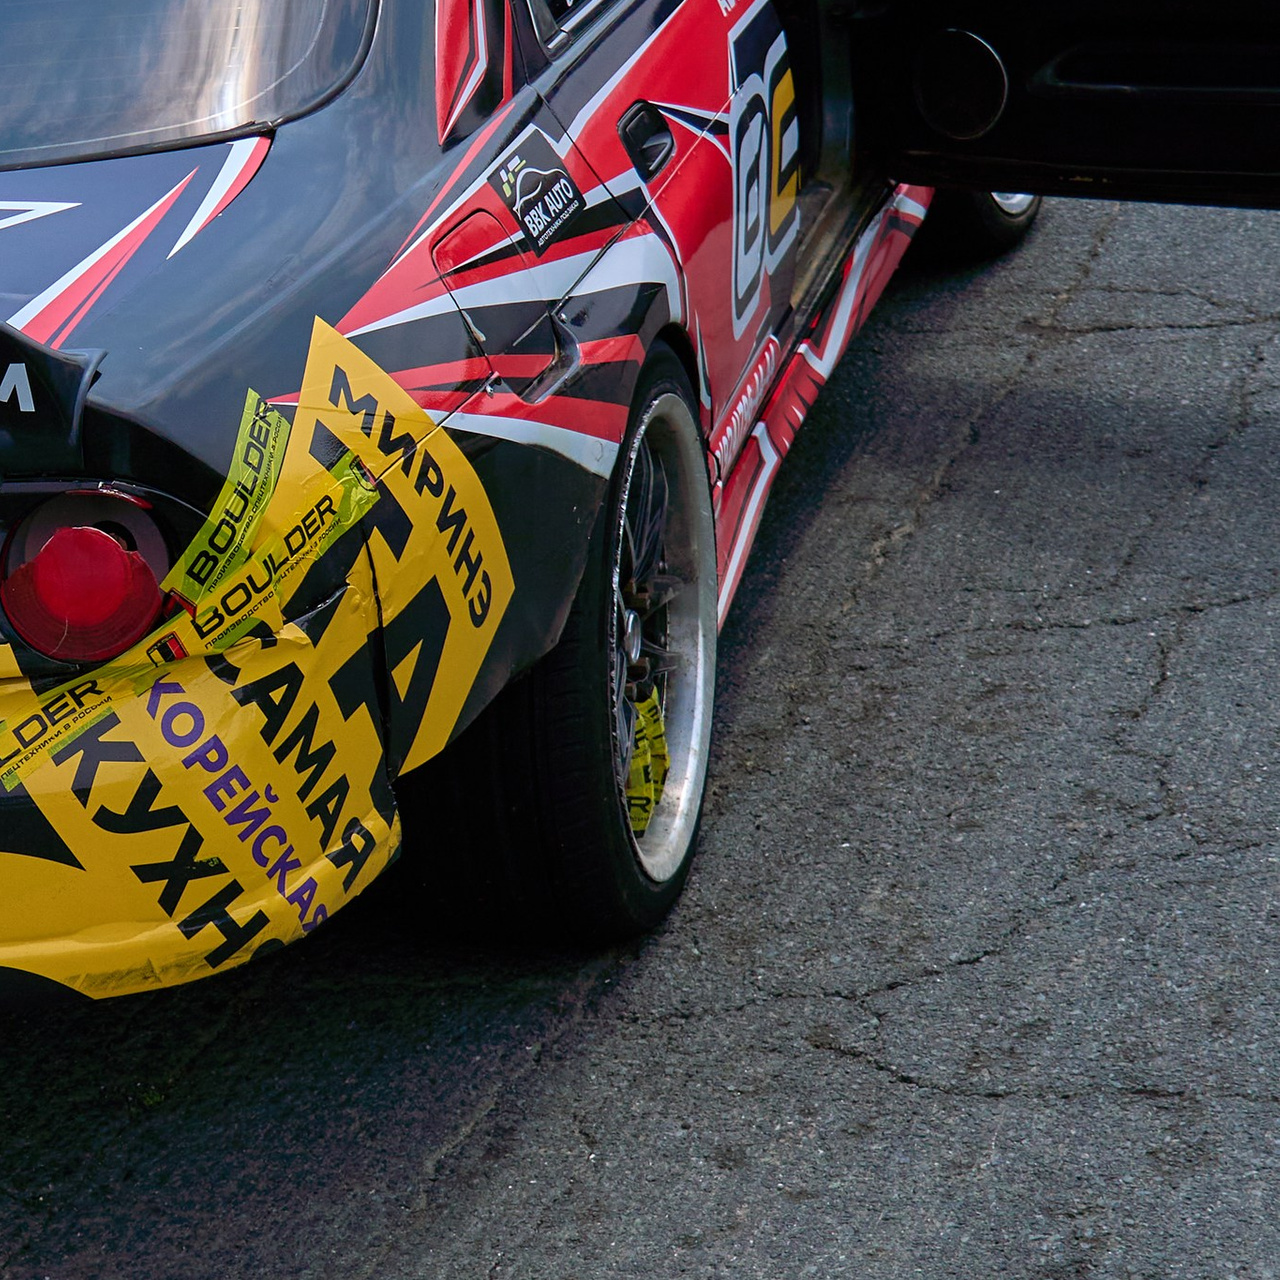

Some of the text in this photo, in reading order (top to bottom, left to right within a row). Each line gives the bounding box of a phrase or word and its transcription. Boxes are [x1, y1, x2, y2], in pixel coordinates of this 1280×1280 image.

[523, 178, 574, 238] BBK AUTO
[186, 400, 278, 587] BOULDER
[189, 493, 339, 640] BOULDER
[329, 362, 493, 629] МИРИНЭ
[204, 590, 275, 651] ПРОИЗВОДСТВО
[142, 673, 329, 934] КОРЕЙСКАЯ
[206, 618, 377, 894] САМАЯ
